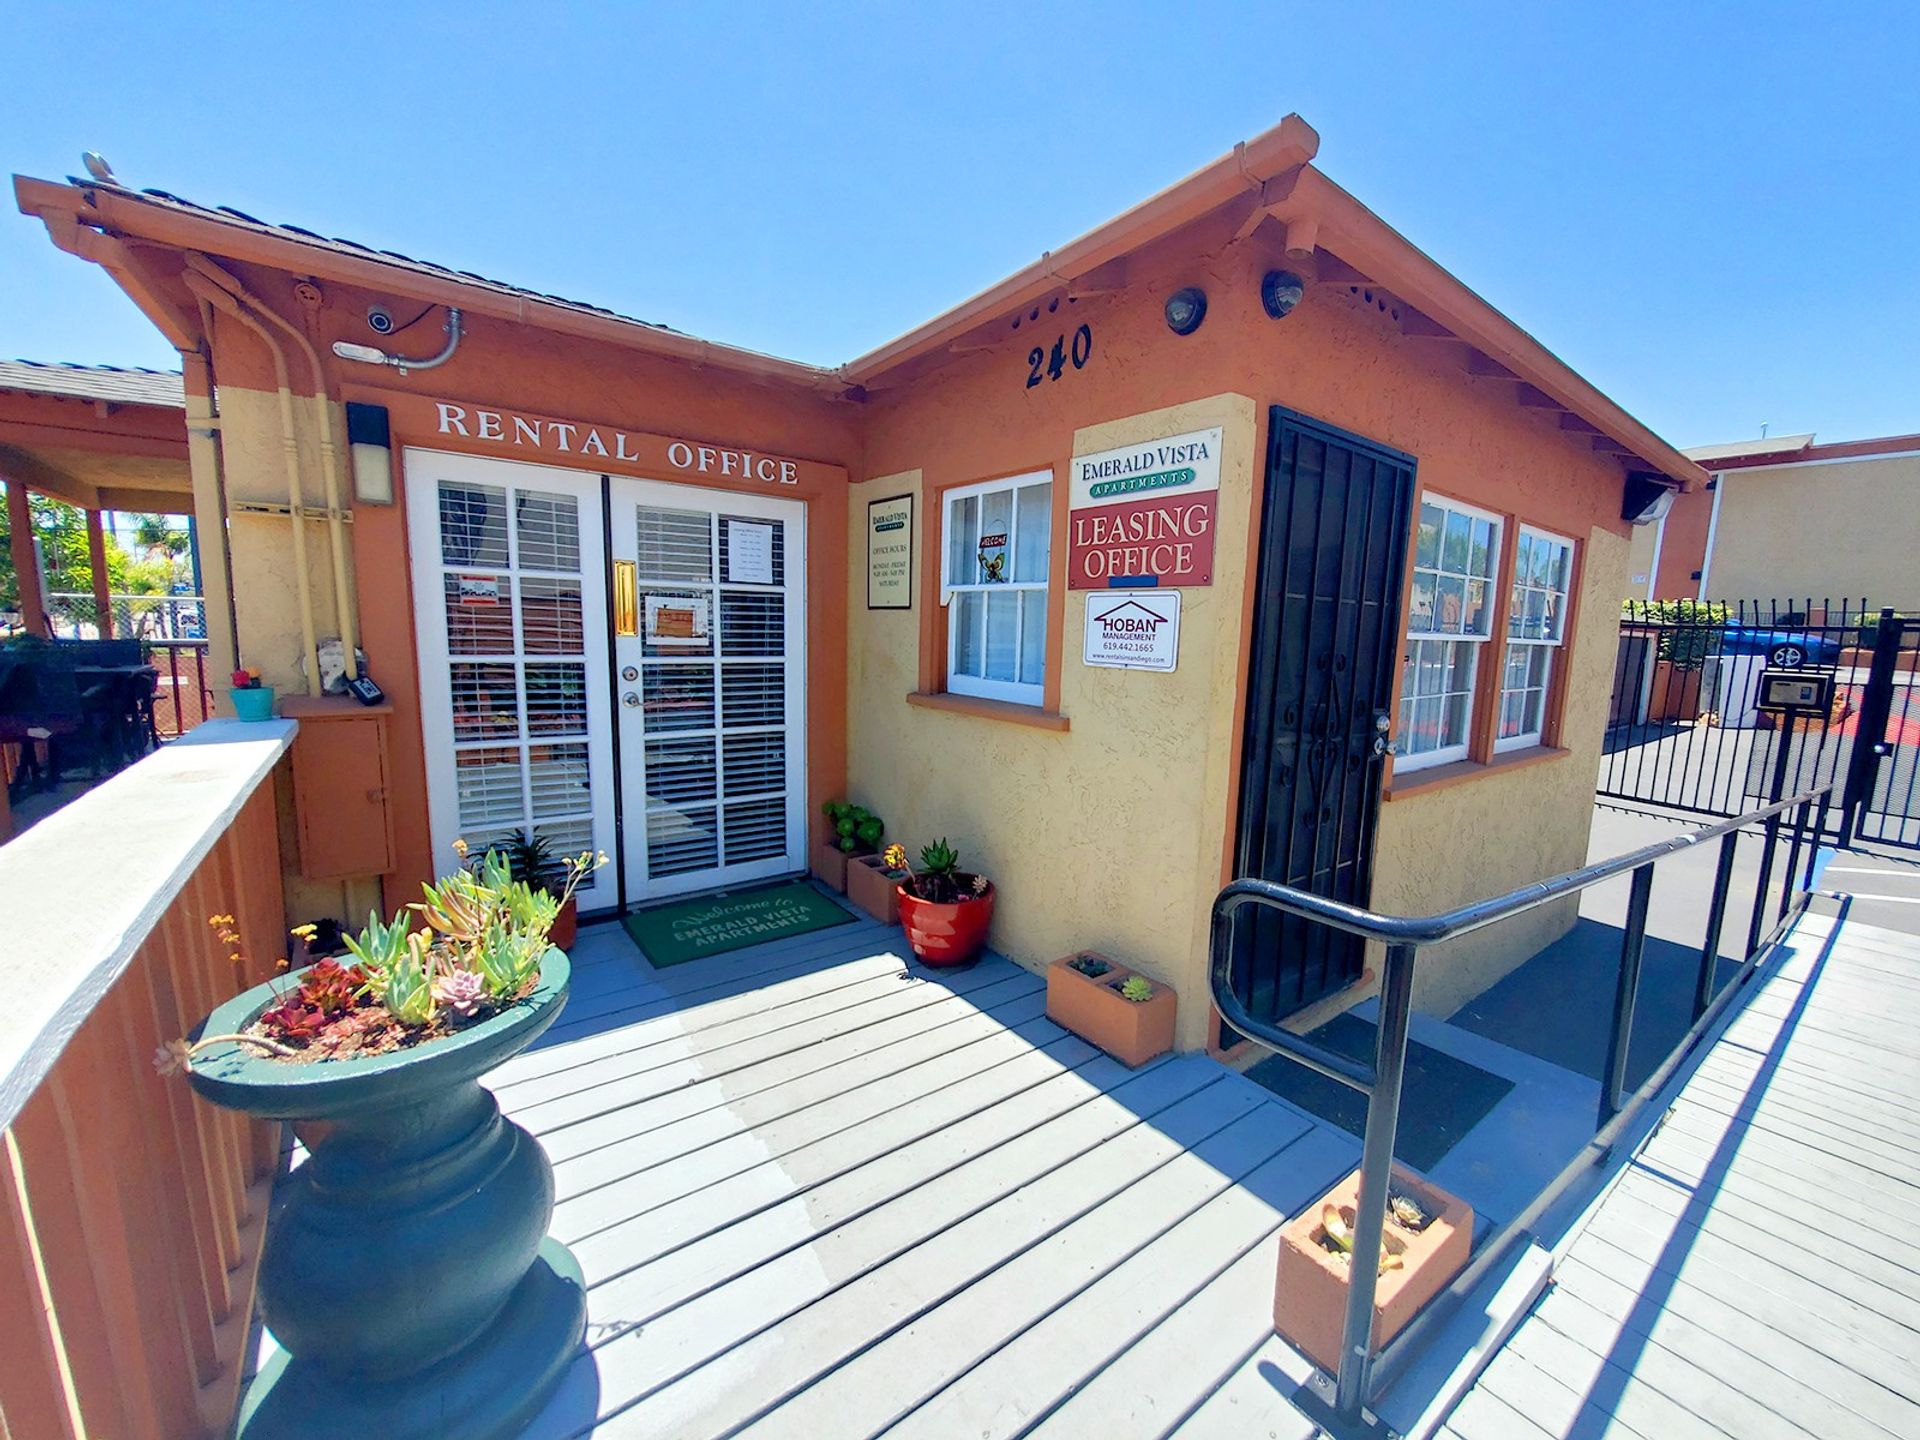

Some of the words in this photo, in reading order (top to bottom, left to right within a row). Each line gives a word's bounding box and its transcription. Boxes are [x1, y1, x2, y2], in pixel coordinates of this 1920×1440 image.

[1026, 324, 1092, 389] 240
[436, 403, 640, 461] RENTAL
[667, 442, 800, 486] OFFICE
[1082, 452, 1154, 481] EMERALD
[1157, 442, 1209, 467] VISTA
[1094, 470, 1188, 495] APARTMENTS
[1076, 504, 1209, 547] LEASING
[1083, 542, 1194, 578] OFFICE
[1102, 632, 1157, 641] MANAGEMENT
[1103, 618, 1157, 633] HOBAN
[1103, 641, 1154, 653] 619.442.1665
[672, 901, 770, 929] Welcome
[674, 916, 758, 941] EMERALD
[763, 905, 811, 921] VISTA
[696, 914, 810, 947] APARTMENTS
